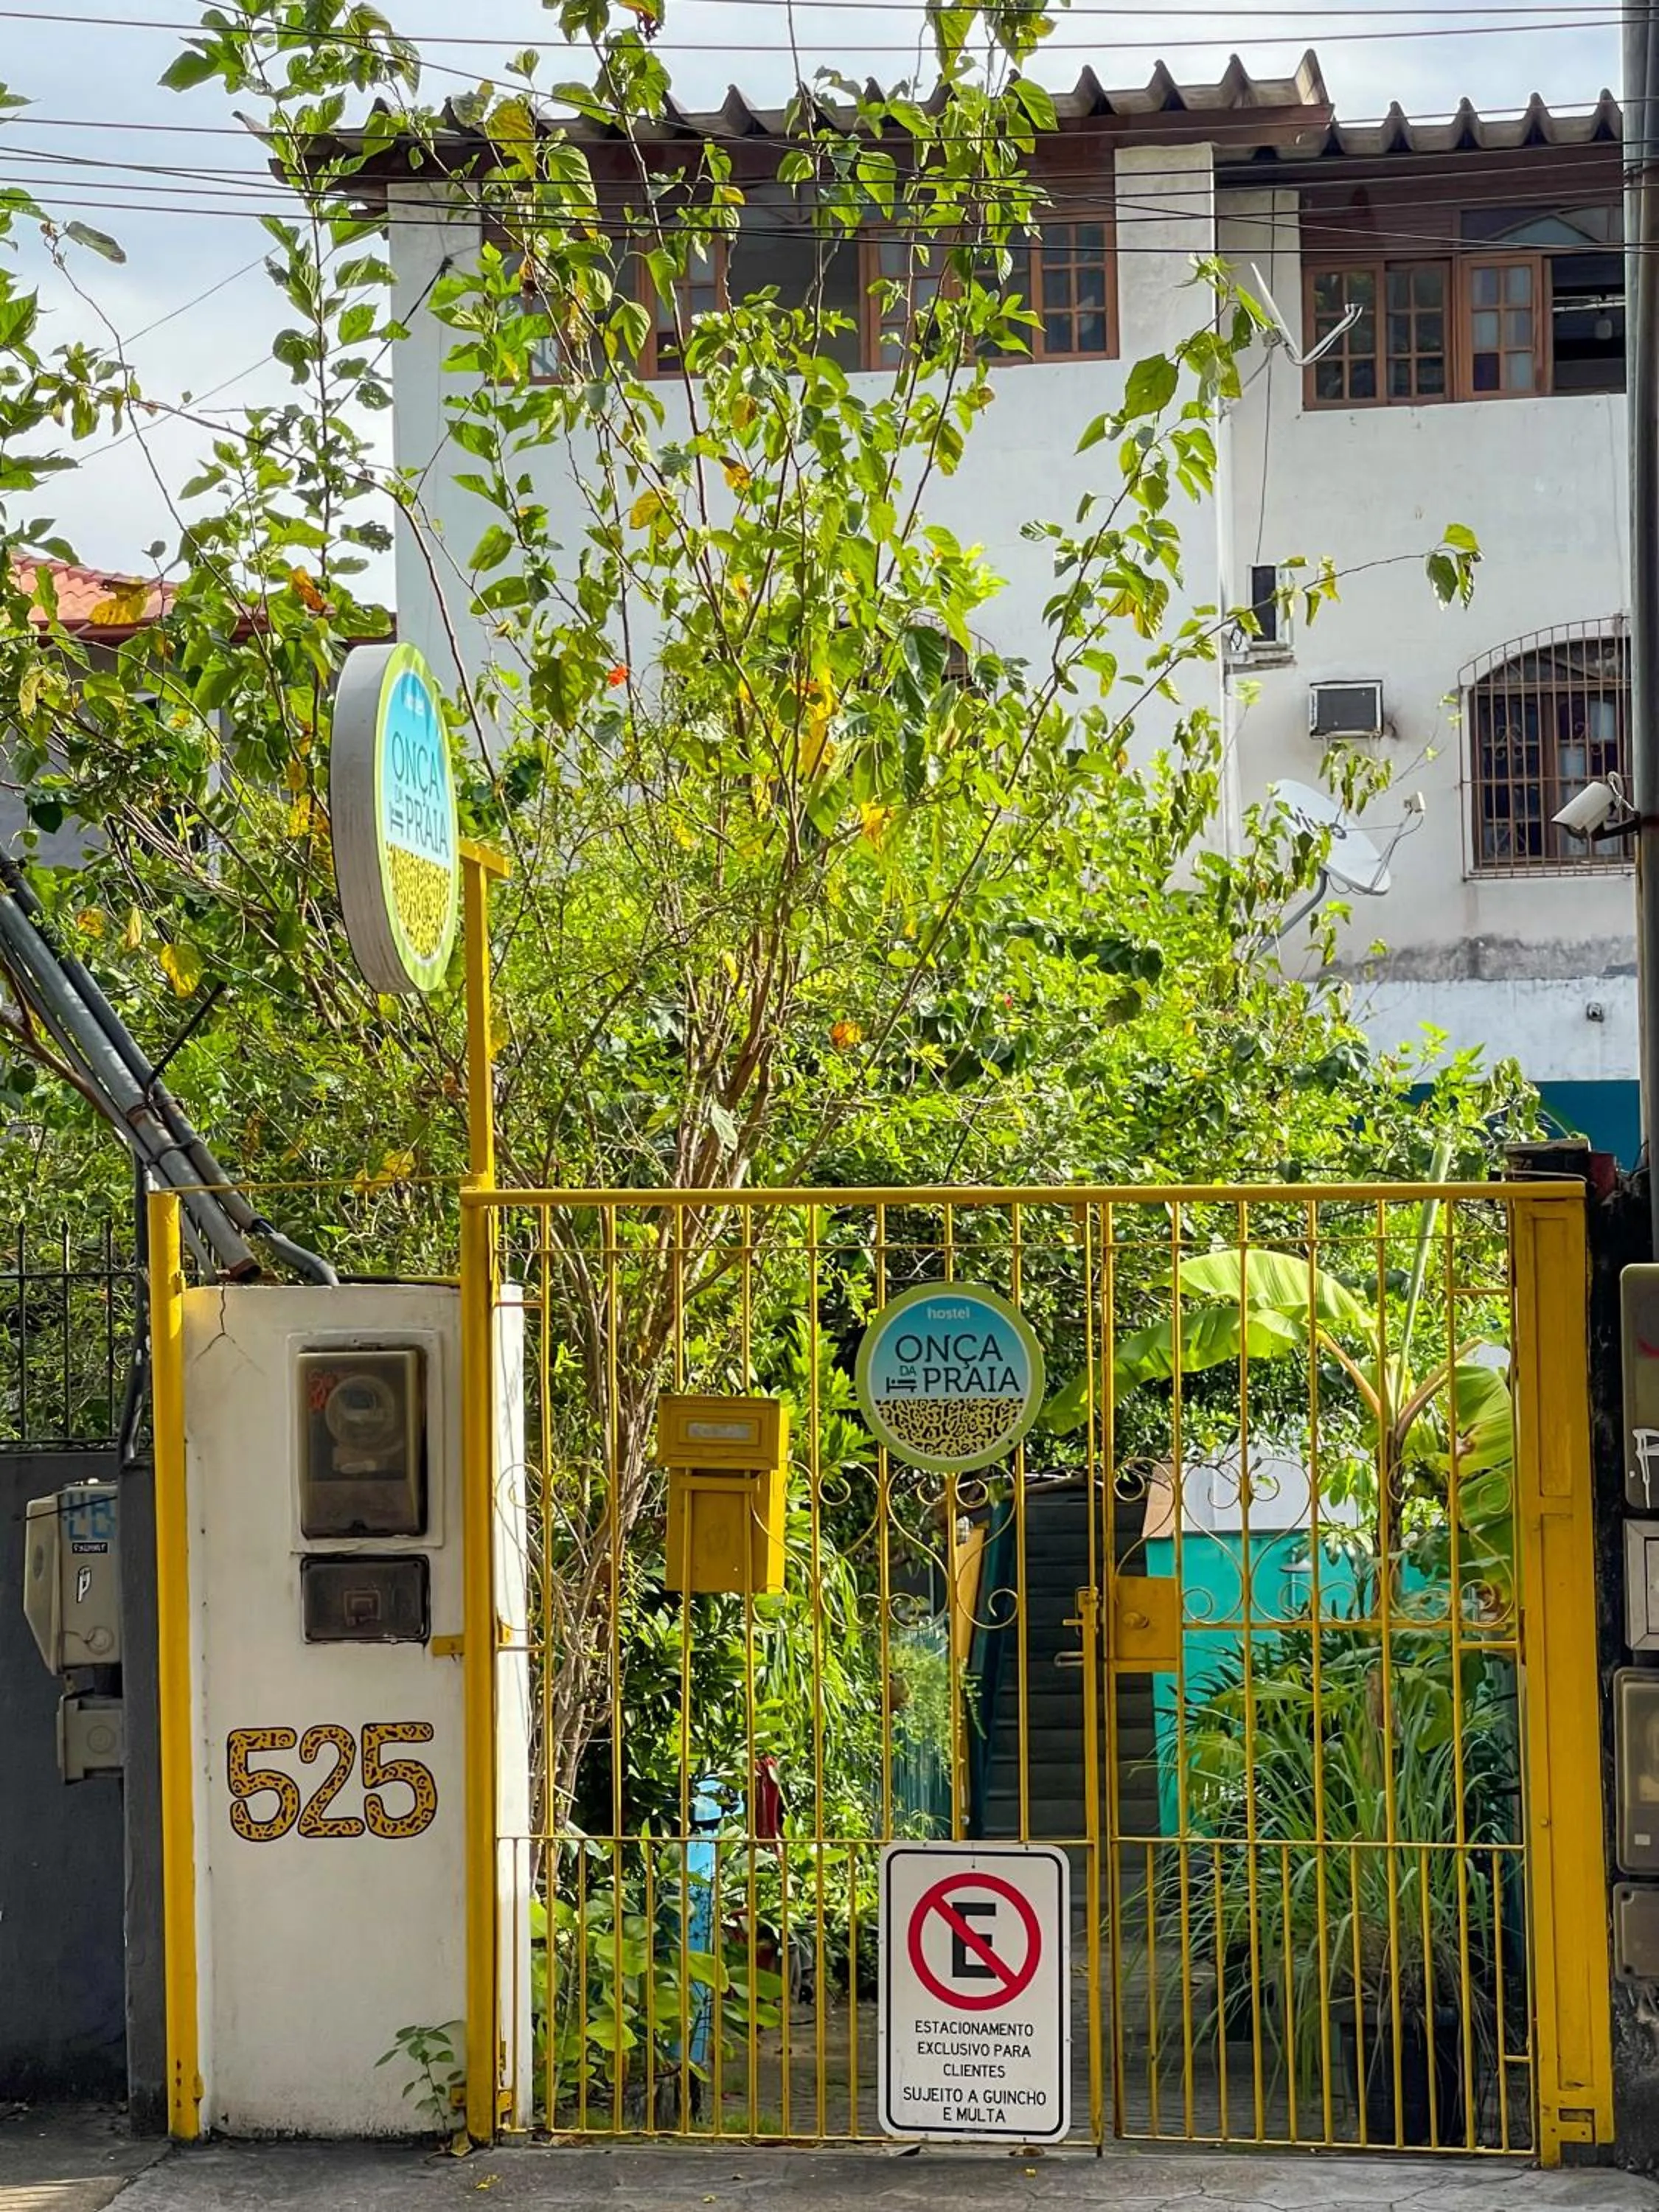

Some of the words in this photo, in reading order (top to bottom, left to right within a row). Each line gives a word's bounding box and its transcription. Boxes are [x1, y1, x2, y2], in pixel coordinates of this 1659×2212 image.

[392, 731, 440, 807] ONÇA
[405, 793, 450, 860] PRAIA
[927, 1307, 970, 1320] hostel
[895, 1334, 1004, 1368] ONÇA
[900, 1366, 917, 1377] DA
[923, 1366, 1020, 1393] PRAIA
[227, 1722, 438, 1843] 525
[915, 2020, 1034, 2037] ESTACIONAMENTO
[917, 2041, 990, 2056] EXCLUSIVO
[994, 2044, 1032, 2058] PARA
[943, 2063, 1006, 2079] CLIENTES
[903, 2086, 964, 2103] SUJEITO
[967, 2089, 979, 2104] A
[983, 2089, 1047, 2107] GUINCHO
[943, 2107, 952, 2121] E
[956, 2107, 1006, 2124] MULTA
